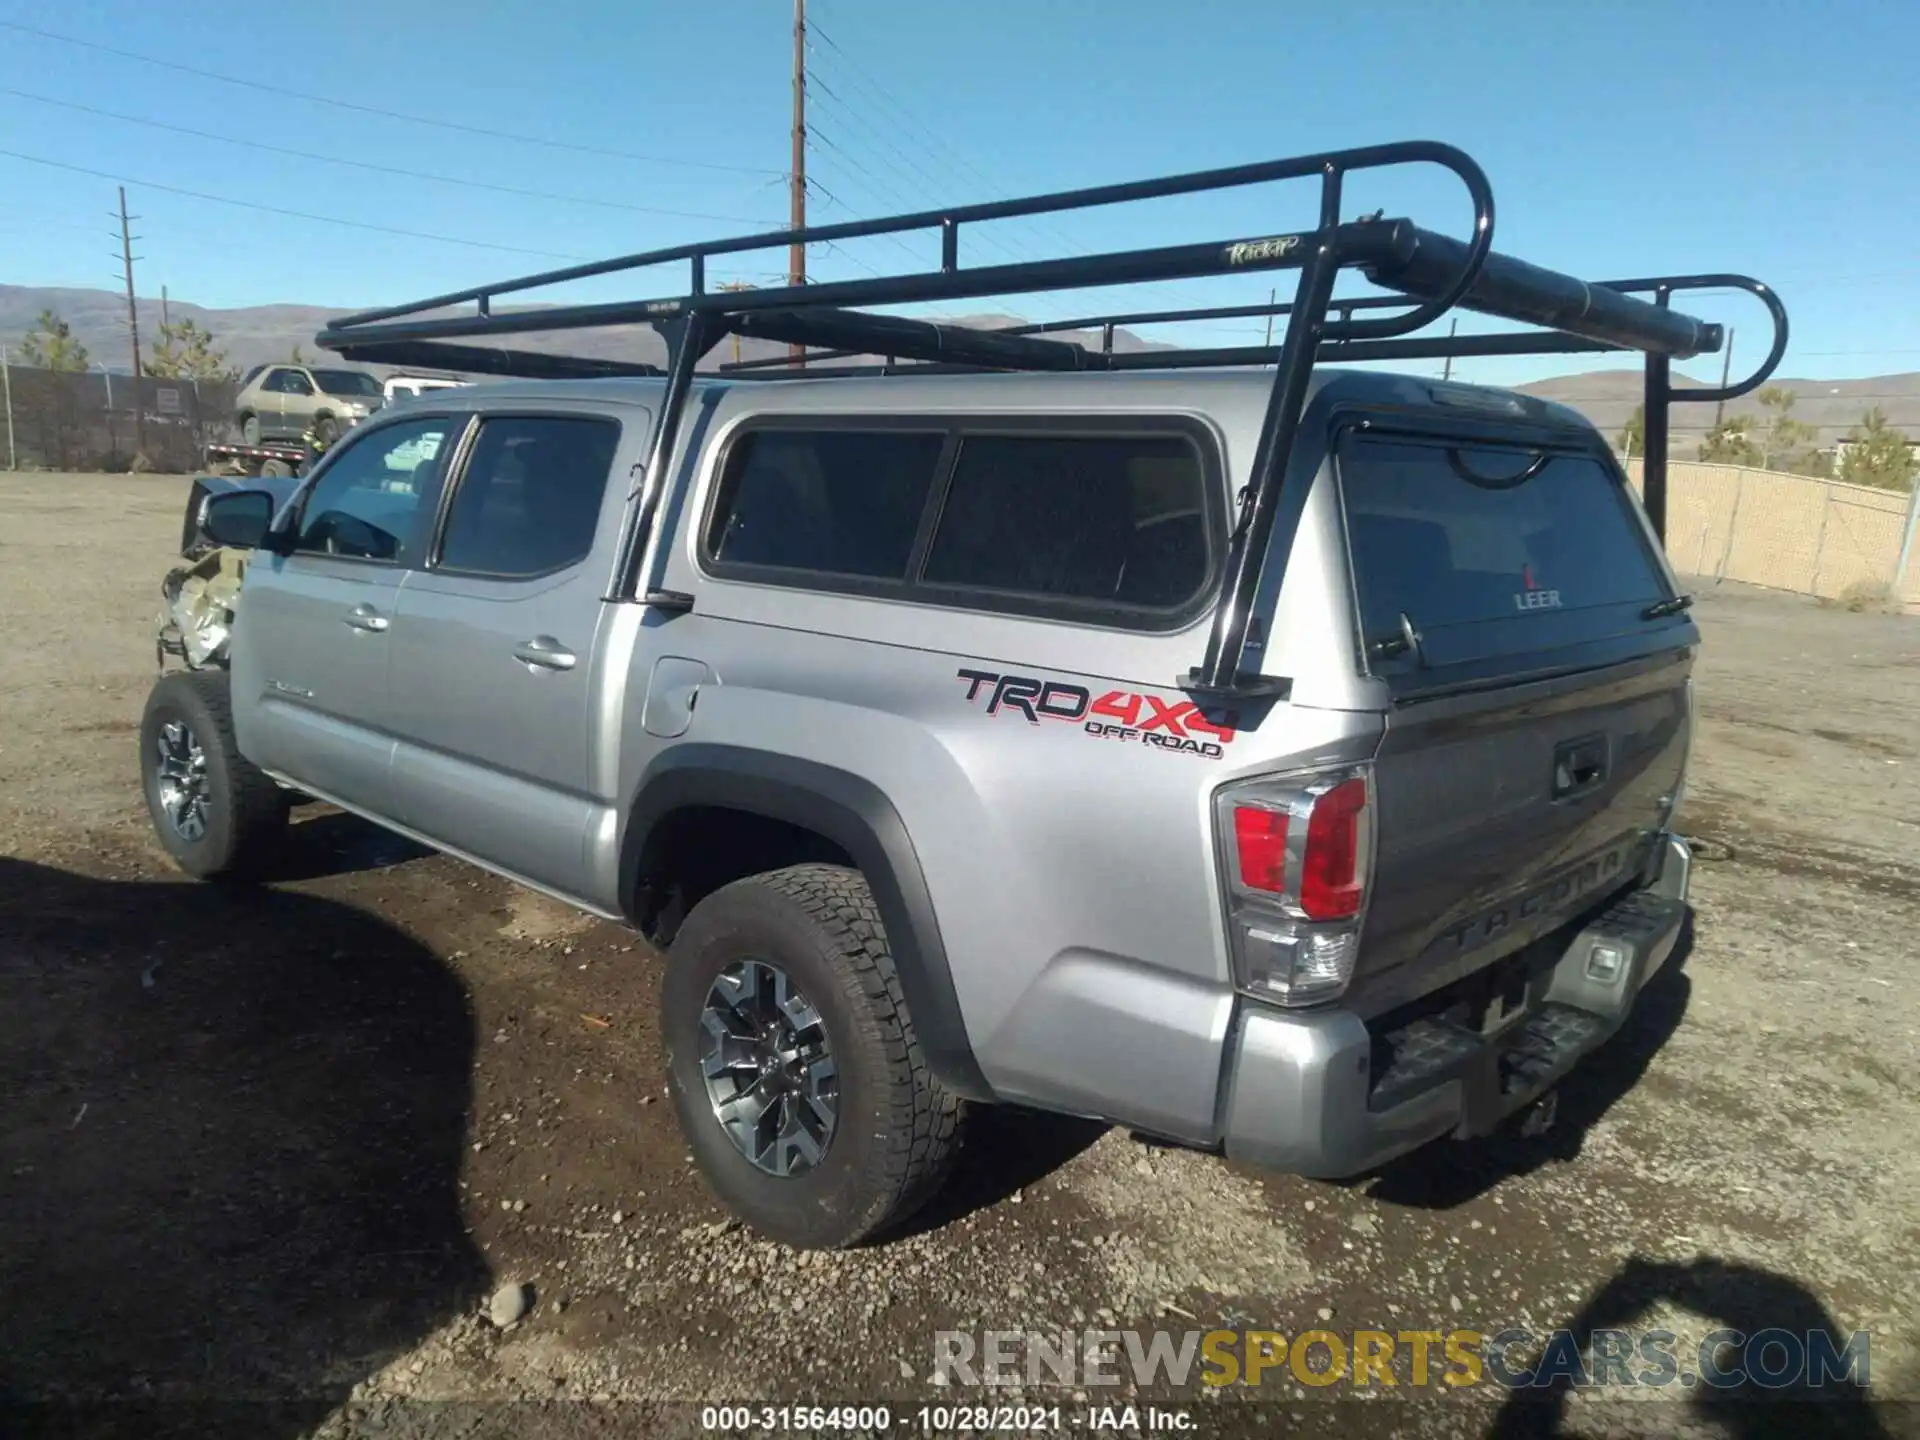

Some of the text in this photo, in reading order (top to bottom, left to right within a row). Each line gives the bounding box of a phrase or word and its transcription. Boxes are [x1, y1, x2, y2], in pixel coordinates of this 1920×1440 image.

[1514, 590, 1564, 610] LEER
[957, 668, 1091, 725] TRD
[1083, 720, 1224, 760] OFF ROAD
[1445, 850, 1620, 948] TACOMA
